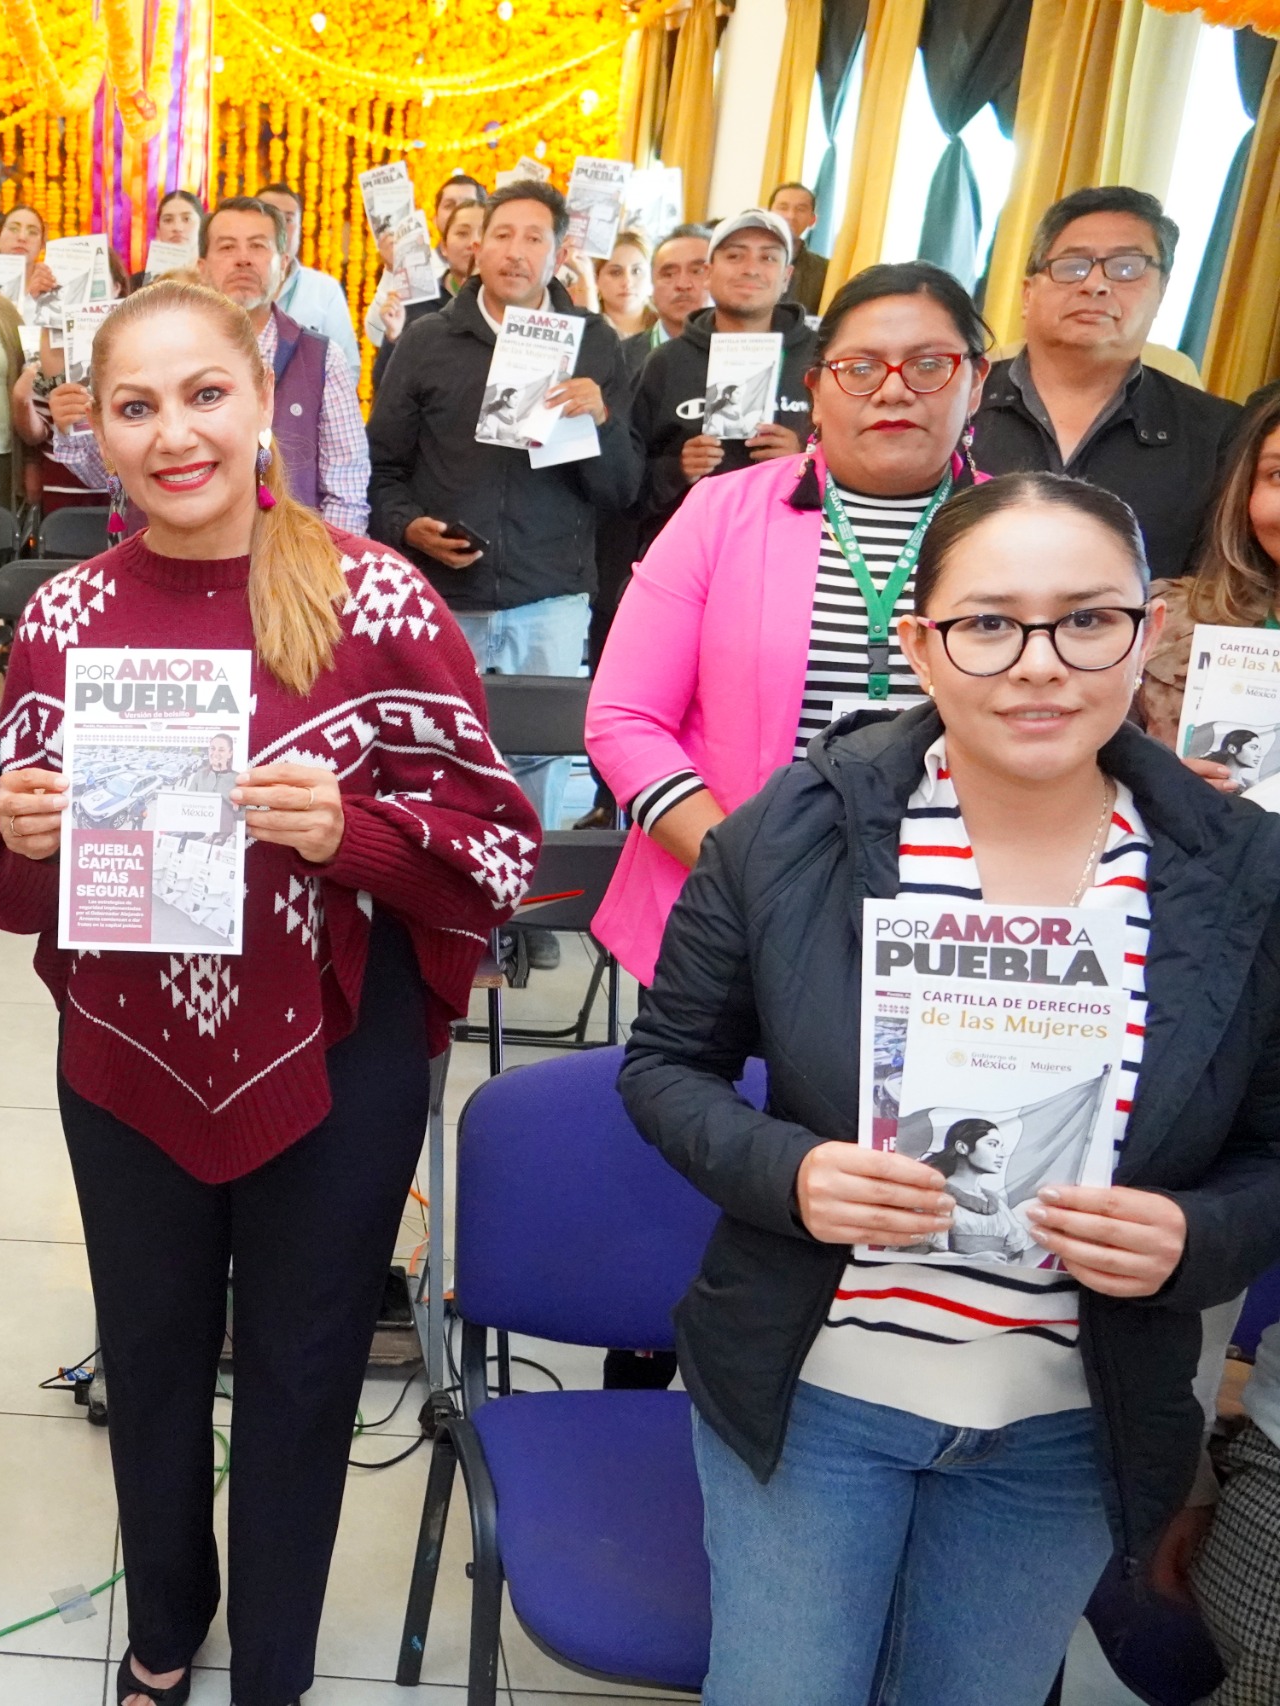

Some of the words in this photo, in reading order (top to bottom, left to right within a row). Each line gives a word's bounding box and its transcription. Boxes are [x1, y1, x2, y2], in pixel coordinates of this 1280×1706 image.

[575, 167, 625, 184] PUEBLA
[527, 314, 569, 330] AMOR
[505, 322, 575, 347] PUEBLA
[1220, 642, 1270, 656] CARTILLA
[1272, 649, 1280, 657] D
[75, 665, 114, 680] POR
[114, 658, 214, 682] AMOR
[214, 667, 229, 682] A
[1217, 653, 1237, 668] de
[1242, 655, 1266, 672] las
[74, 682, 240, 714] PUEBLA
[1245, 688, 1277, 700] México
[124, 711, 152, 719] Versión
[152, 711, 163, 719] de
[163, 710, 190, 718] bolsillo
[181, 808, 214, 818] México
[79, 843, 144, 858] ¡PUEBLA
[78, 856, 145, 871] CAPITAL
[92, 868, 129, 884] MÁS
[76, 884, 145, 899] SEGURA!
[876, 917, 932, 940] POR
[930, 913, 1073, 946] AMOR
[1072, 927, 1093, 947] A
[875, 940, 1109, 987] PUEBLA
[922, 990, 998, 1008] CARTILLA
[1002, 997, 1023, 1010] DE
[1027, 998, 1112, 1016] DERECHOS
[920, 1006, 951, 1026] de
[959, 1009, 995, 1031] las
[1004, 1014, 1109, 1040] Mujeres
[970, 1057, 1017, 1071] México
[1030, 1060, 1072, 1073] Mujeres
